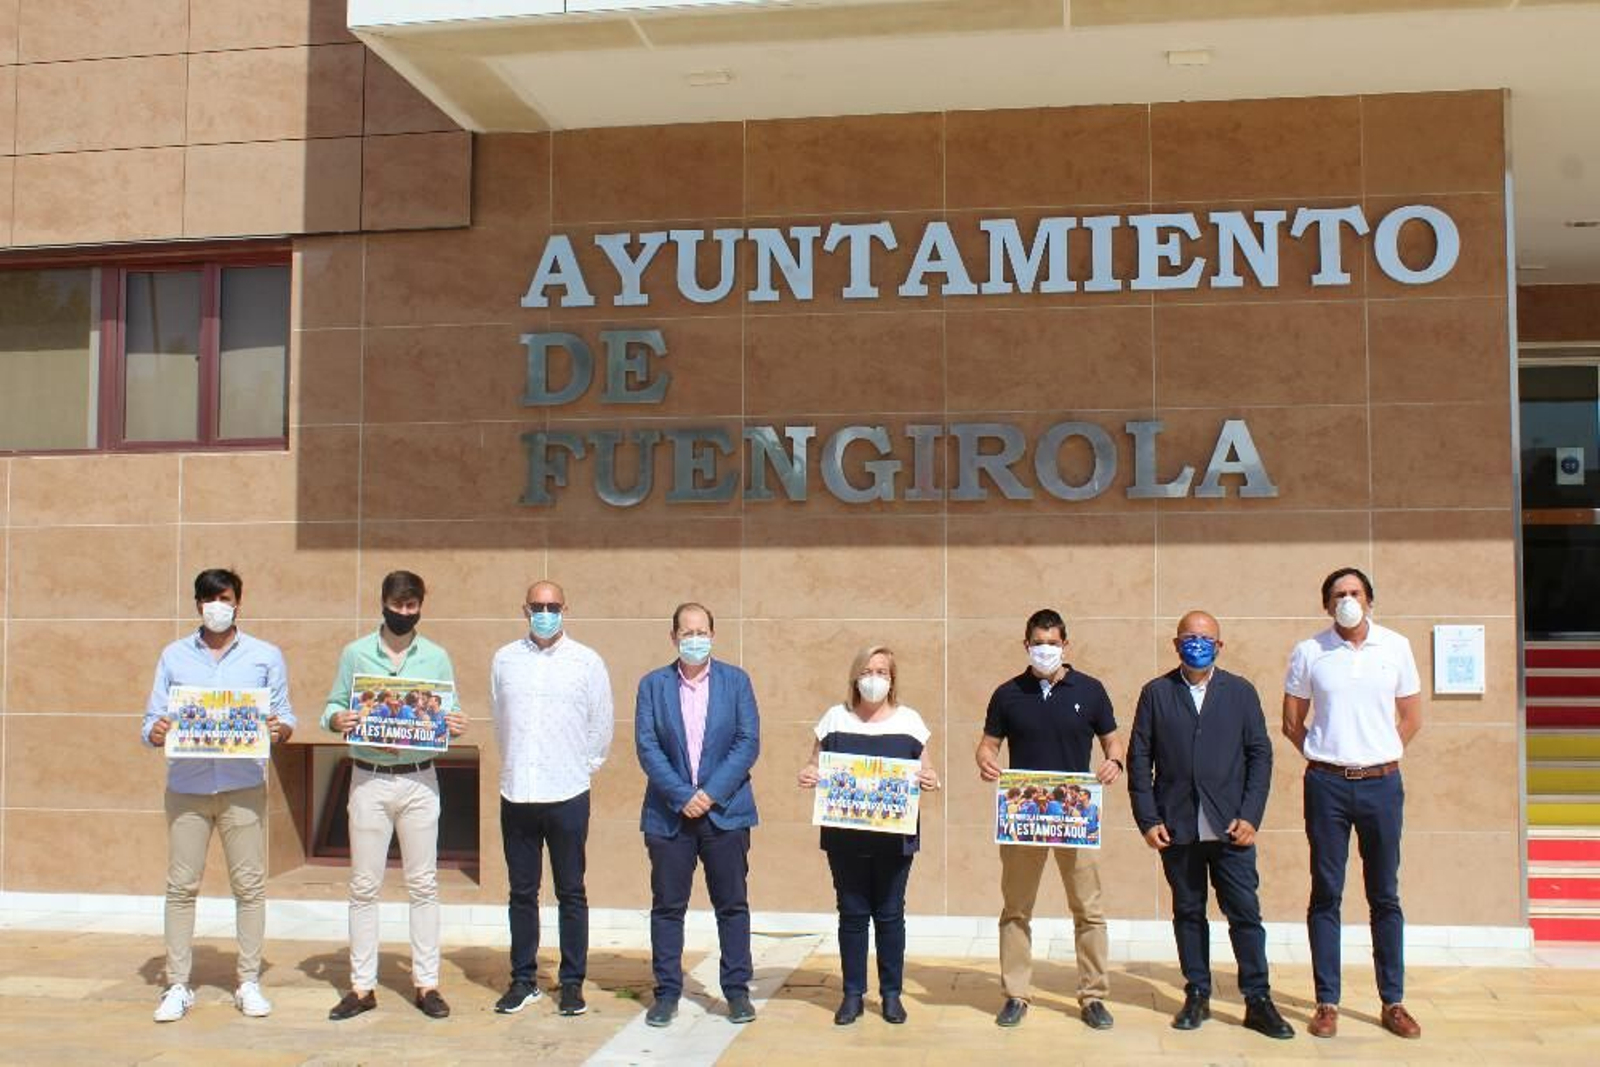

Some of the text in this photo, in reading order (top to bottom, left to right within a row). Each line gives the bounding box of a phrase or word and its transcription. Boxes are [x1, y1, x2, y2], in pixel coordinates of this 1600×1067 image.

[519, 204, 1461, 309] AYUNTAMIENTO
[519, 328, 670, 407] DE
[518, 418, 1279, 507] FUENGIROLA
[367, 725, 414, 740] ESTAMOS
[1003, 821, 1015, 835] YA
[1016, 822, 1064, 838] ESTAMOS
